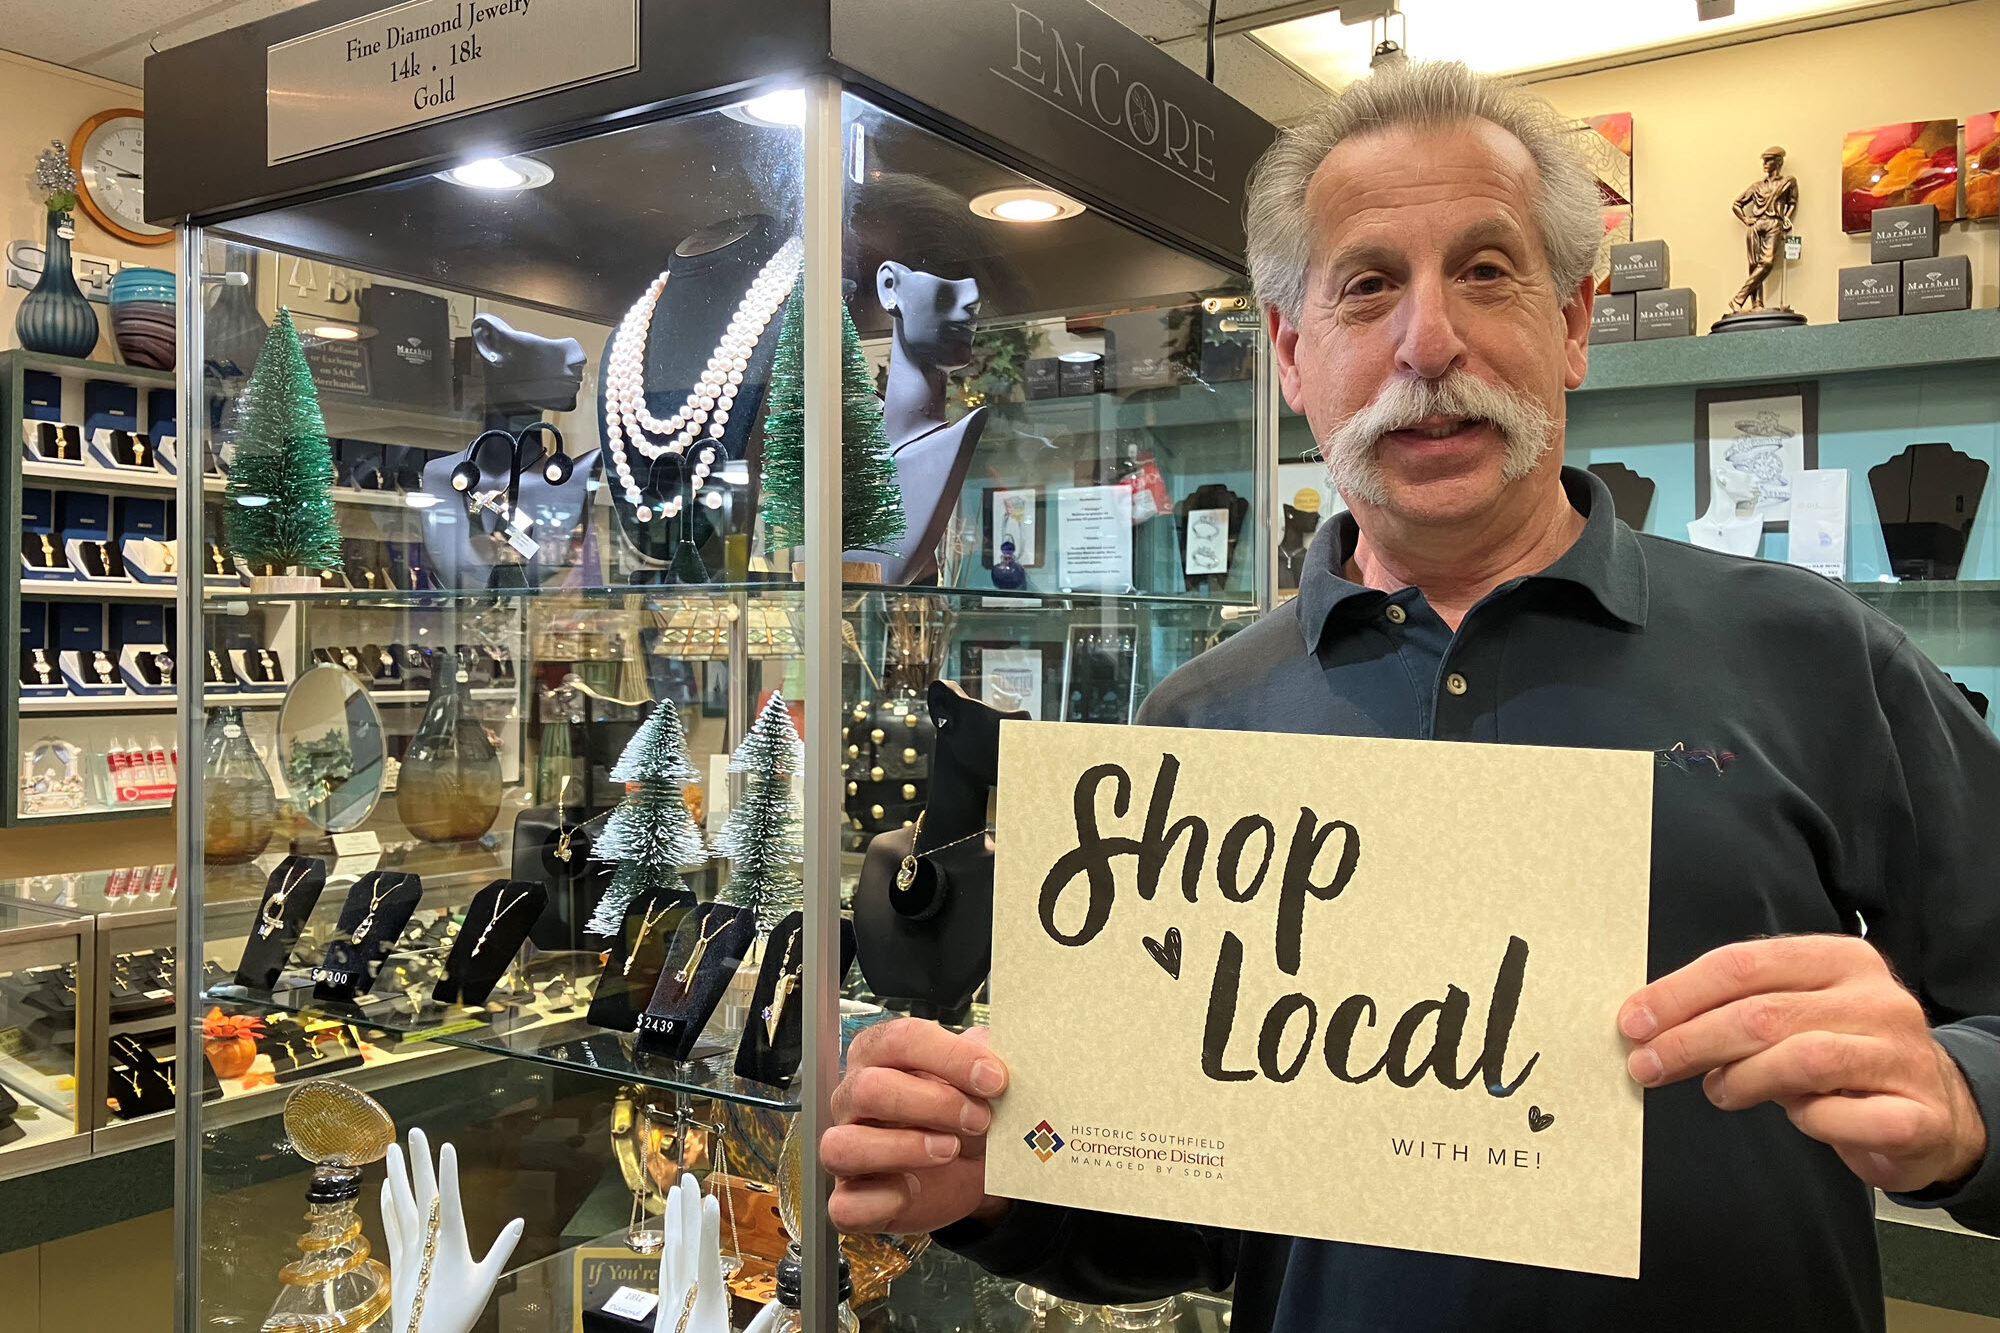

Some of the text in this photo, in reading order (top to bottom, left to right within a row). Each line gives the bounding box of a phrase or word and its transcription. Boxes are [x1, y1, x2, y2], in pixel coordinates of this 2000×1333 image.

[346, 0, 530, 62] Fine Diamond Jewelry
[390, 52, 420, 83] 14k
[450, 34, 482, 66] 18k
[414, 76, 455, 110] Gold
[1010, 2, 1216, 183] ENCORE
[1876, 227, 1927, 240] Marshall
[1614, 260, 1658, 272] Marshall
[1844, 285, 1895, 297] Marshall
[1908, 278, 1960, 291] Marshall
[1639, 308, 1684, 320] Marshall
[1038, 753, 1361, 976] Shop
[636, 1013, 674, 1033] $2439
[1202, 931, 1541, 1098] Local
[1071, 1125, 1225, 1150] HISTORIC SOUTHFIELD
[1070, 1138, 1225, 1168] Cornerstone District
[1392, 1138, 1540, 1169] WITH ME!
[1071, 1156, 1223, 1180] MANAGED BY SDDA
[588, 1262, 657, 1288] If You're
